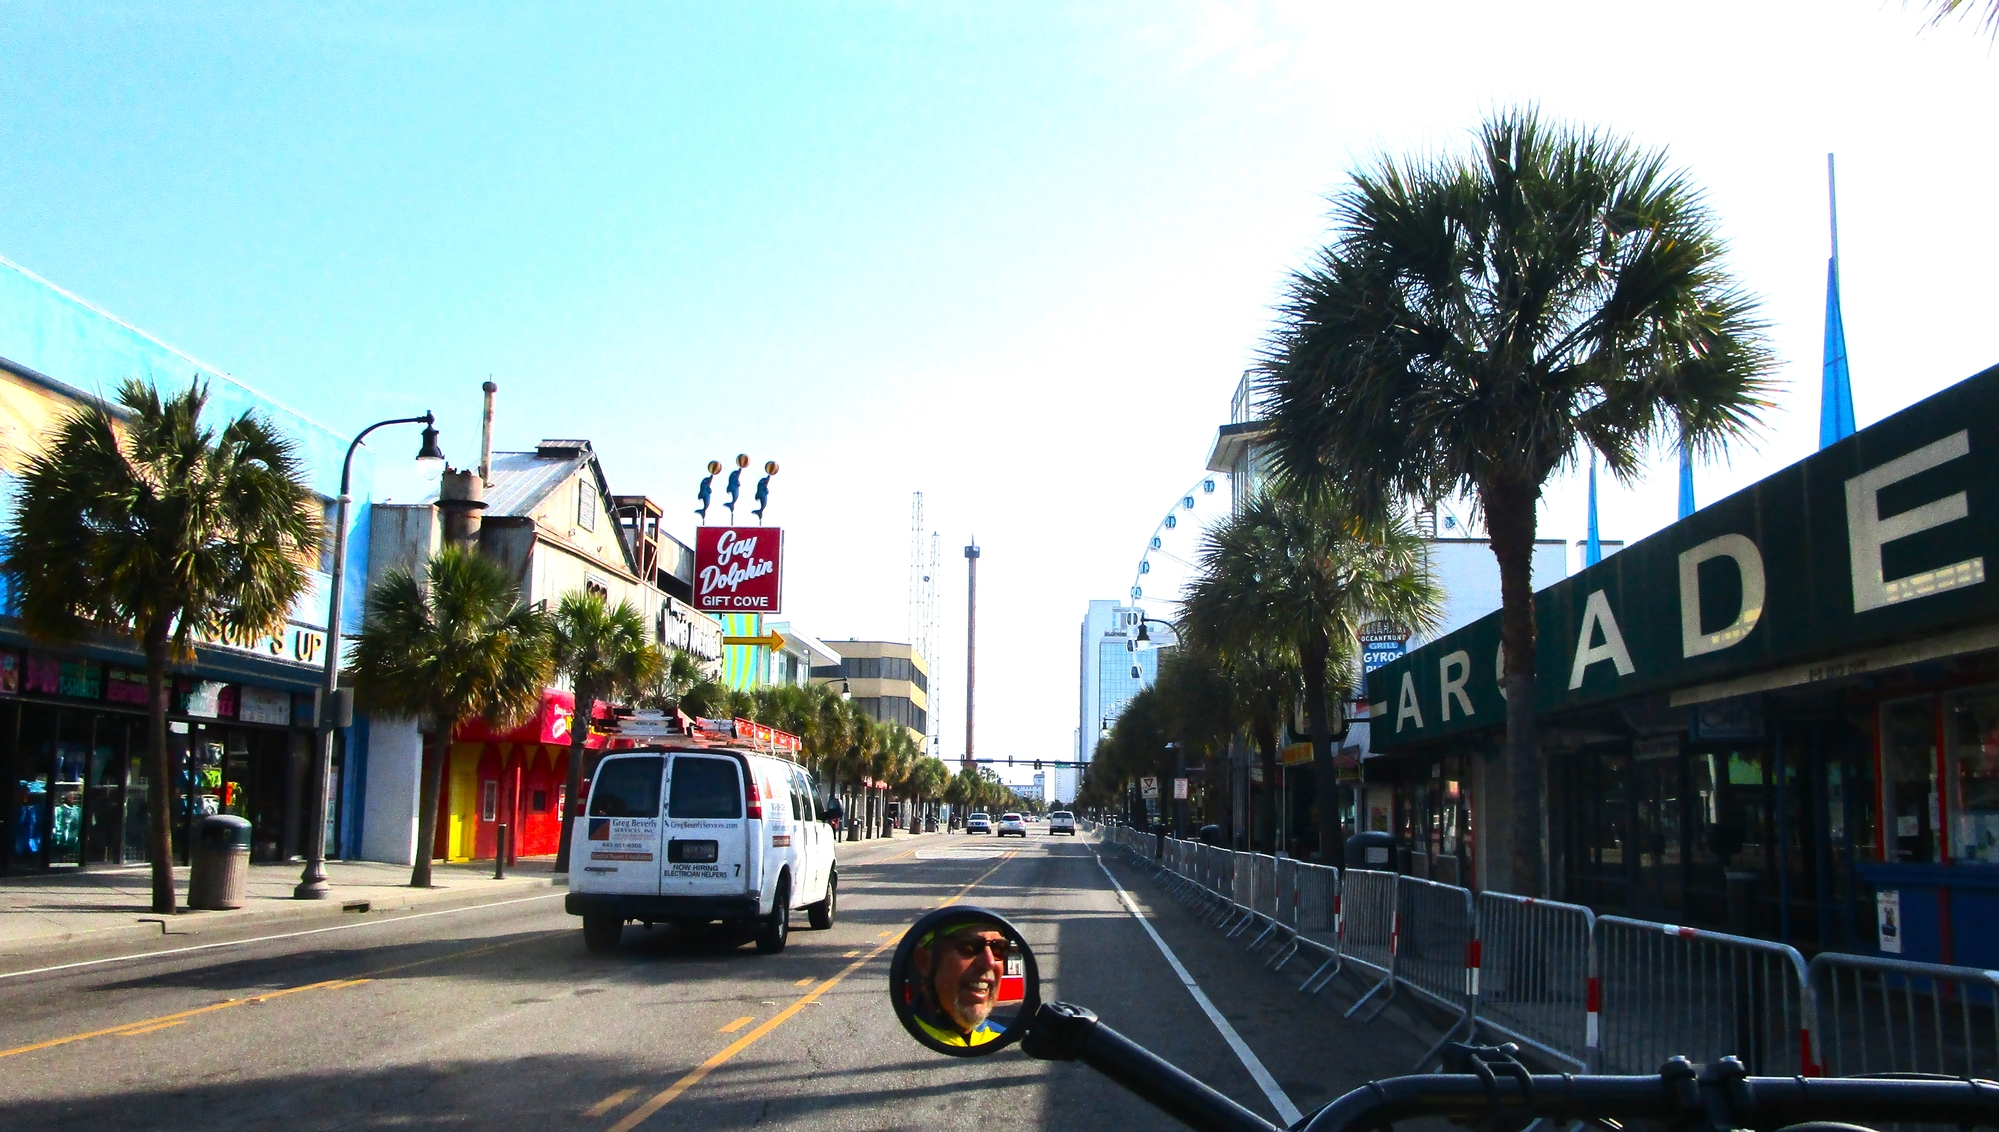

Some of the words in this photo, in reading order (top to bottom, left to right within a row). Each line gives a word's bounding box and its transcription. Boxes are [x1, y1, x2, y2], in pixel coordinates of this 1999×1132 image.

[716, 530, 758, 566] Gay
[699, 558, 774, 596] Dolphin
[1396, 429, 1985, 733] ARADE
[702, 596, 732, 607] GIFT
[733, 596, 769, 607] COVE
[1360, 634, 1407, 642] OCEANFRONT
[296, 630, 324, 661] UP
[1369, 642, 1398, 650] GRILL
[612, 819, 630, 828] Greg
[631, 819, 657, 828] Beverly
[734, 864, 741, 877] 7
